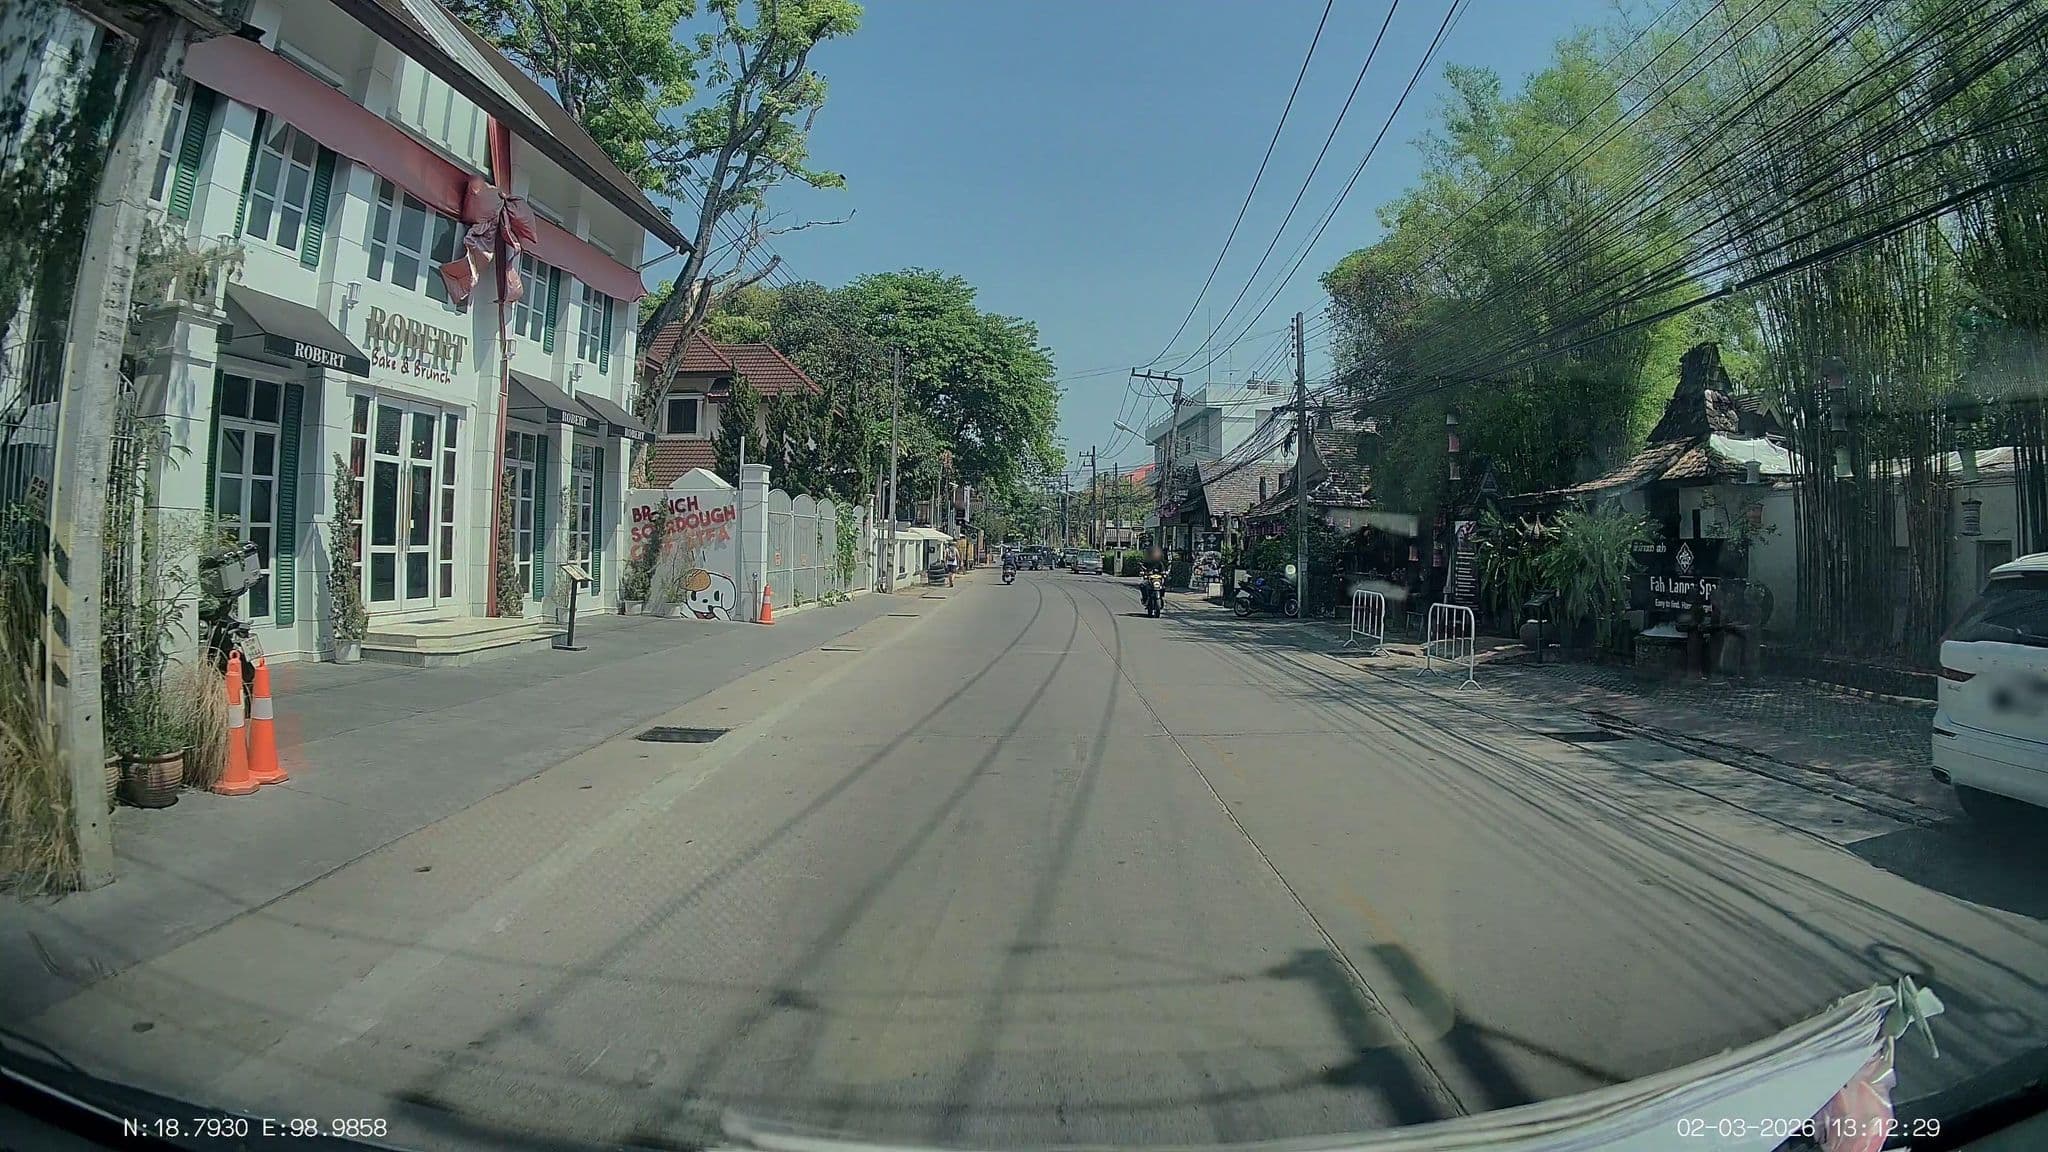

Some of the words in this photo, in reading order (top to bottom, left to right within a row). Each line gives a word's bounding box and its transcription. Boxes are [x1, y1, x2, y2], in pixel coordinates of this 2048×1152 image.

[366, 305, 468, 363] ROBERT
[294, 341, 347, 369] ROBERT
[372, 347, 396, 370] Bake
[400, 356, 410, 374] &
[414, 359, 451, 384] Brunch
[562, 410, 588, 427] ROBERT
[632, 495, 699, 523] BRNCH
[631, 505, 736, 543] SORDOUGH
[1650, 576, 1665, 593] Fah
